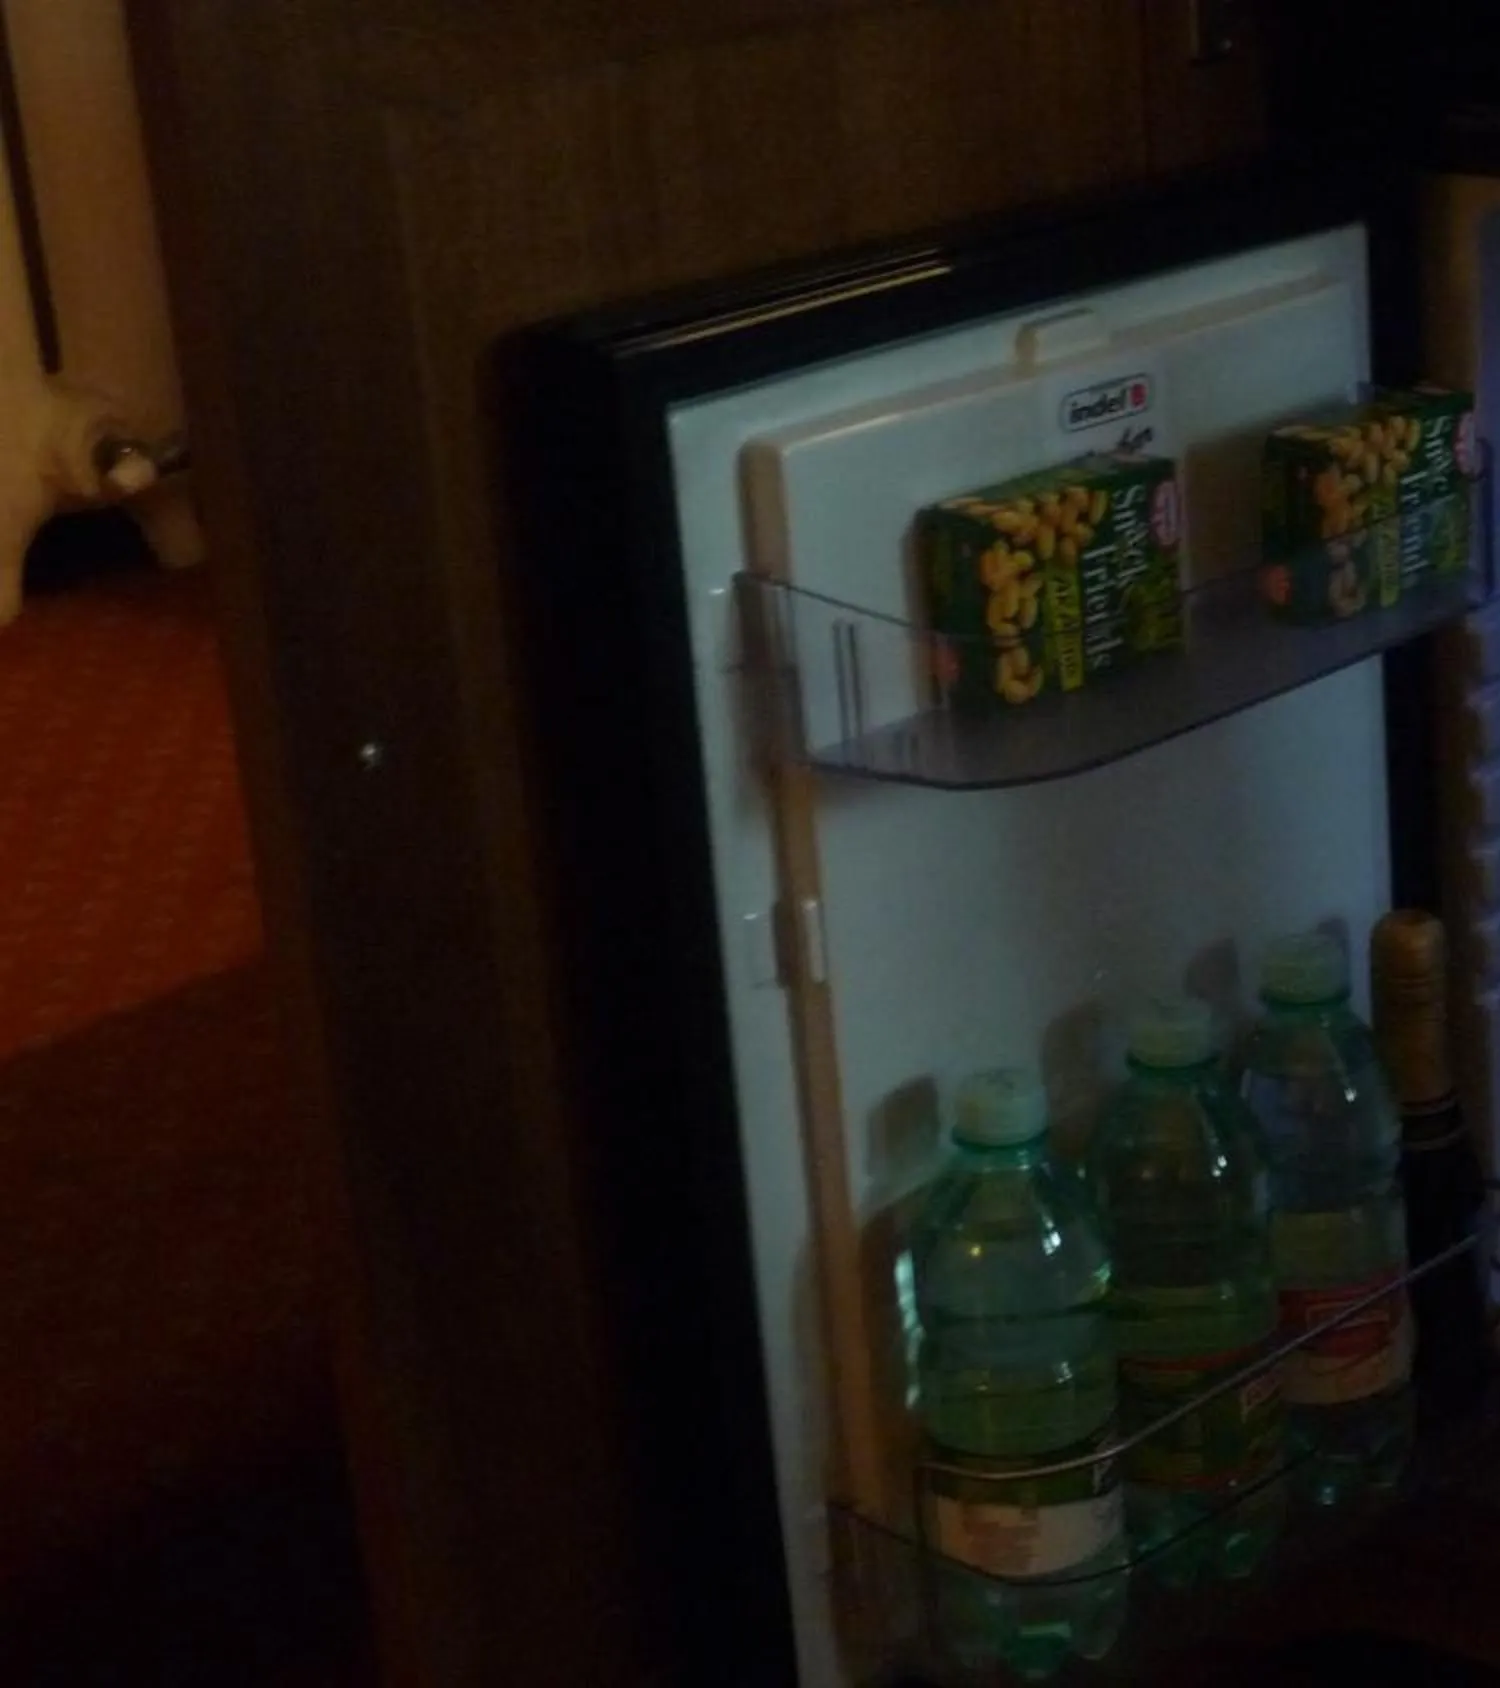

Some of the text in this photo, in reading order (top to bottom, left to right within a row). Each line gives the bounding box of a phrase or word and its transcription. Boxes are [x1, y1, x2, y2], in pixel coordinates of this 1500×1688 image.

[1069, 388, 1126, 424] indel
[1111, 483, 1150, 589] Snack
[1080, 543, 1124, 670] Friends
